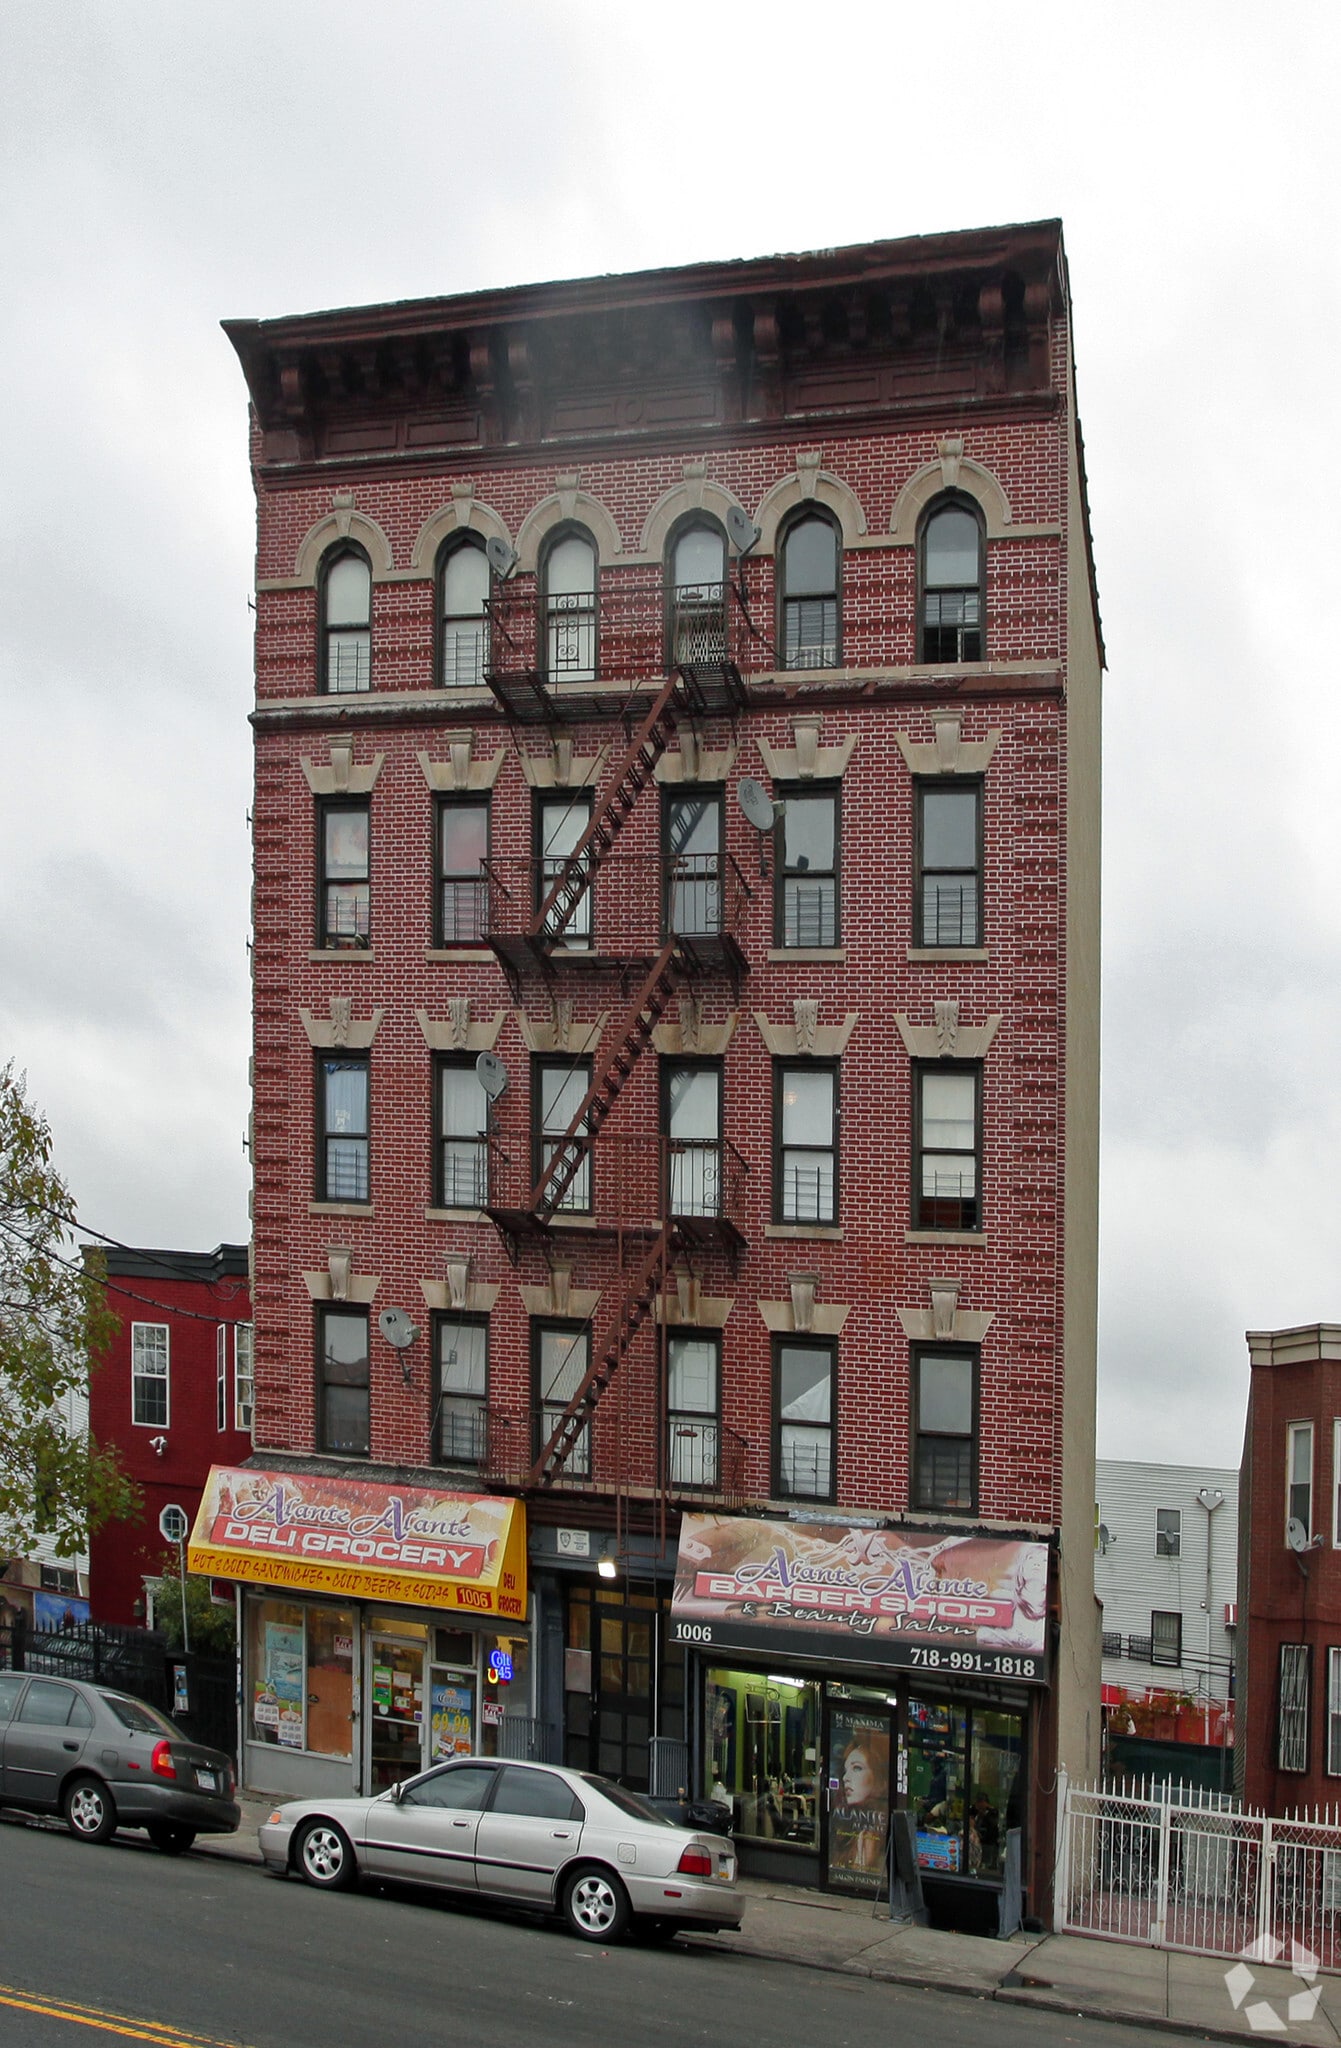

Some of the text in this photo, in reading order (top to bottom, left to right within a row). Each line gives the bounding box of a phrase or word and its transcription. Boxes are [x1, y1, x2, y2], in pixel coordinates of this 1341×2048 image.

[233, 1484, 471, 1542] Alante Alante
[224, 1521, 473, 1569] DELI GROCERY
[192, 1553, 215, 1569] HOT
[223, 1558, 251, 1575] COLD
[253, 1562, 323, 1584] SANDWICHES
[332, 1572, 362, 1590] COLD
[364, 1576, 401, 1596] BEERS
[412, 1583, 449, 1601] SODAS
[503, 1572, 516, 1590] DELI
[735, 1545, 987, 1600] Alante Alante
[460, 1588, 489, 1608] 1006
[498, 1594, 522, 1616] GROCERY
[709, 1579, 996, 1619] BARBER SHOP
[742, 1601, 976, 1636] & Beauty Salon
[676, 1623, 712, 1642] 1006
[490, 1650, 512, 1668] Colt
[910, 1647, 1035, 1677] 718-991-1818
[498, 1667, 512, 1679] 45
[487, 1705, 499, 1713] FOR
[845, 1716, 884, 1728] MAXIMA
[832, 1807, 887, 1826] ALANTE
